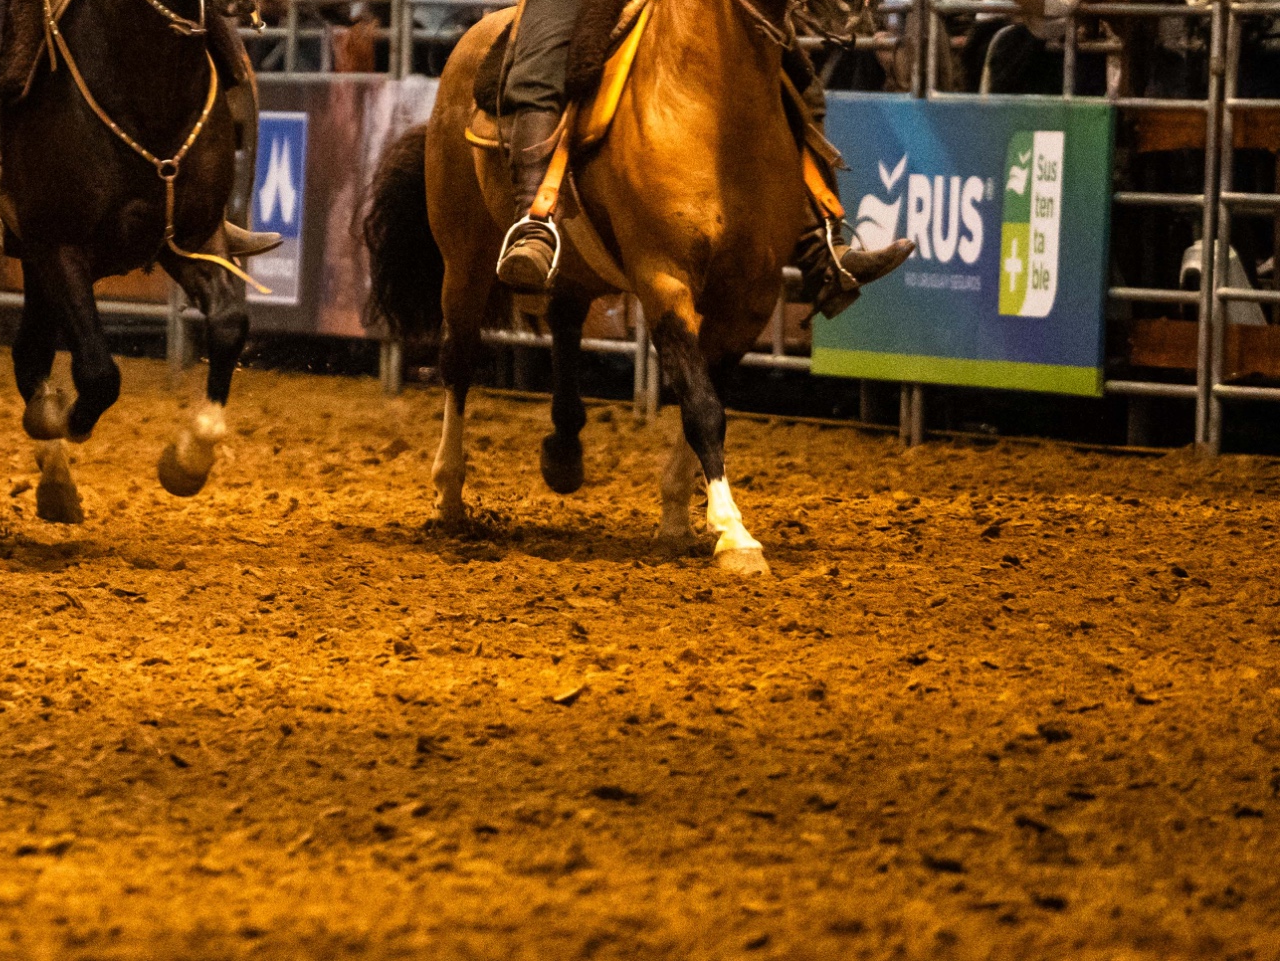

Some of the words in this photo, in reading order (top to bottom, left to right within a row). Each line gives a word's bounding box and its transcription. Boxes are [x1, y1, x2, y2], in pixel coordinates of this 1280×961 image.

[1036, 153, 1058, 182] Sus
[907, 173, 985, 265] RUS
[1034, 194, 1054, 219] ten
[1033, 229, 1045, 254] ta
[1032, 262, 1050, 291] ble
